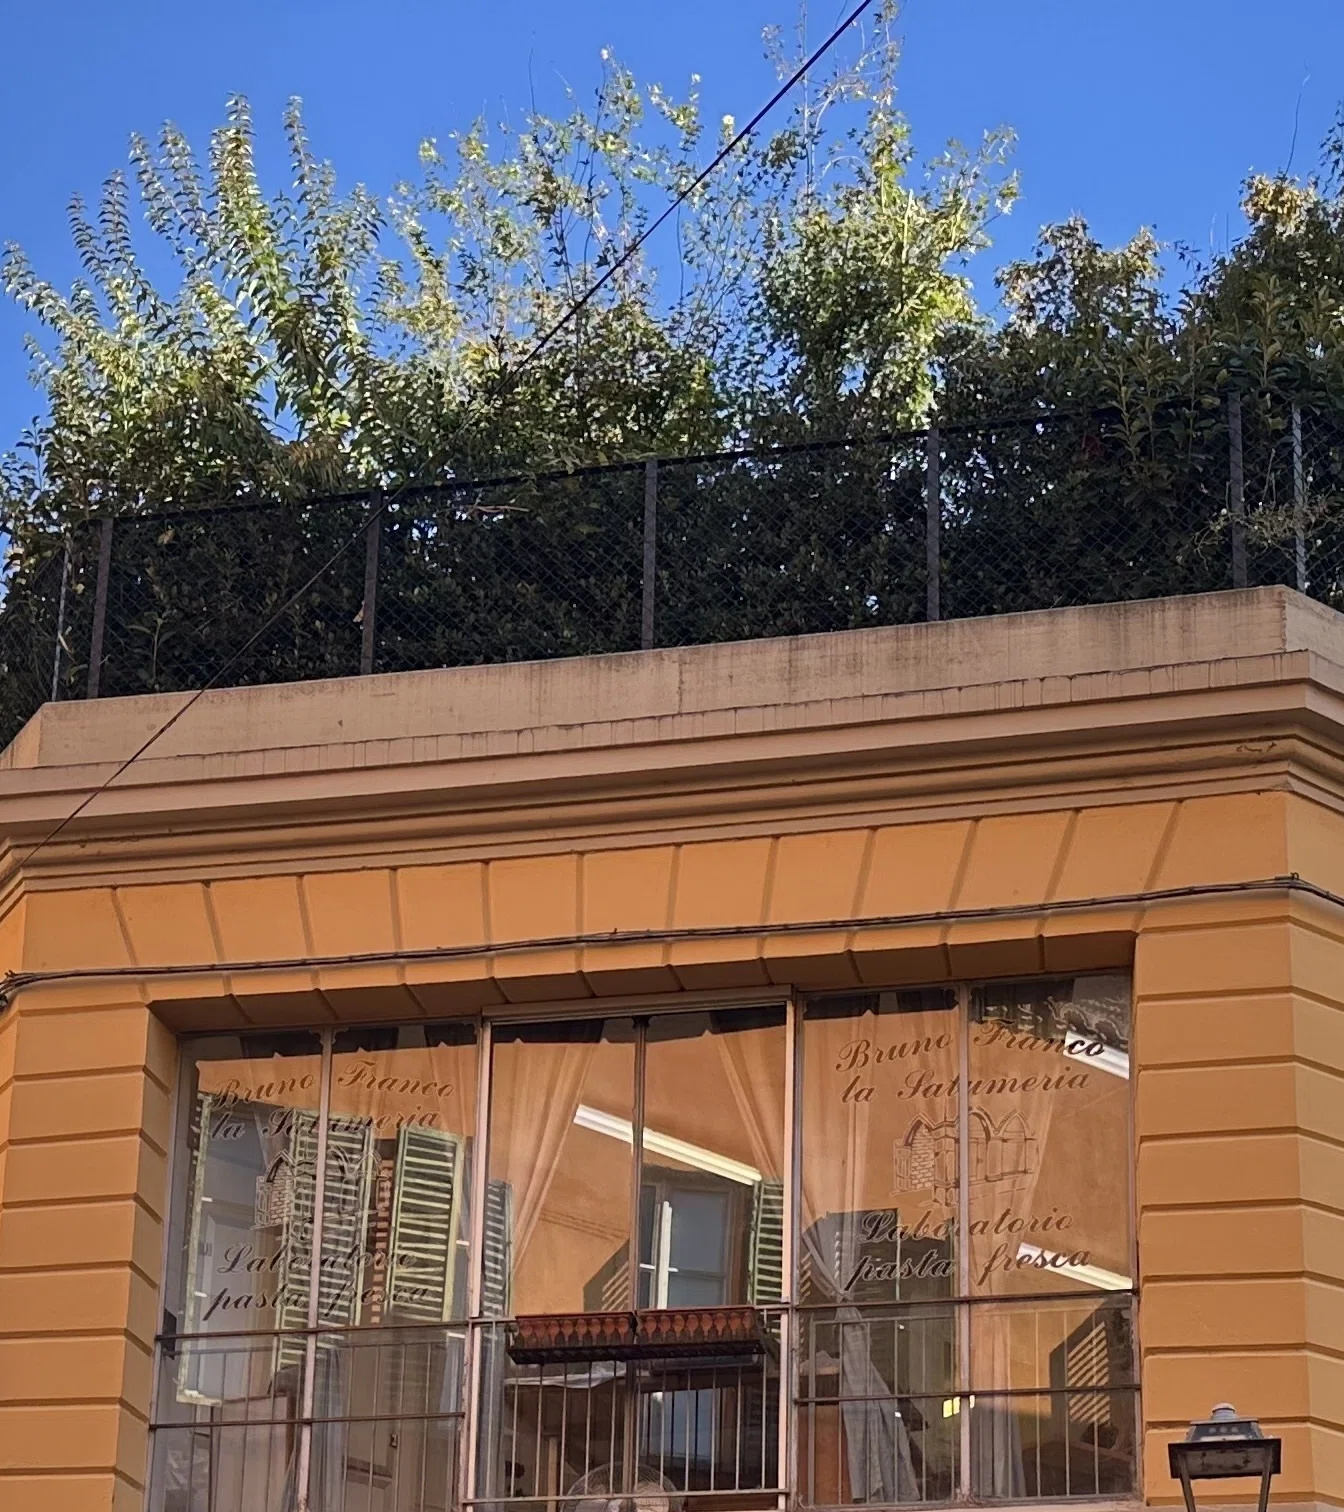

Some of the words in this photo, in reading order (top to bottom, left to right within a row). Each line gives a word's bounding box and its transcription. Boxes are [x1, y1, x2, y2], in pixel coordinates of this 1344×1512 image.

[835, 1032, 954, 1072] Bruno
[972, 1019, 1105, 1058] Franco
[207, 1072, 316, 1110] Bruno
[336, 1059, 456, 1098] Franco
[840, 1075, 877, 1104] la
[216, 1242, 418, 1276] Laboatorio
[843, 1248, 954, 1293] pasta
[976, 1241, 1092, 1287] fresca
